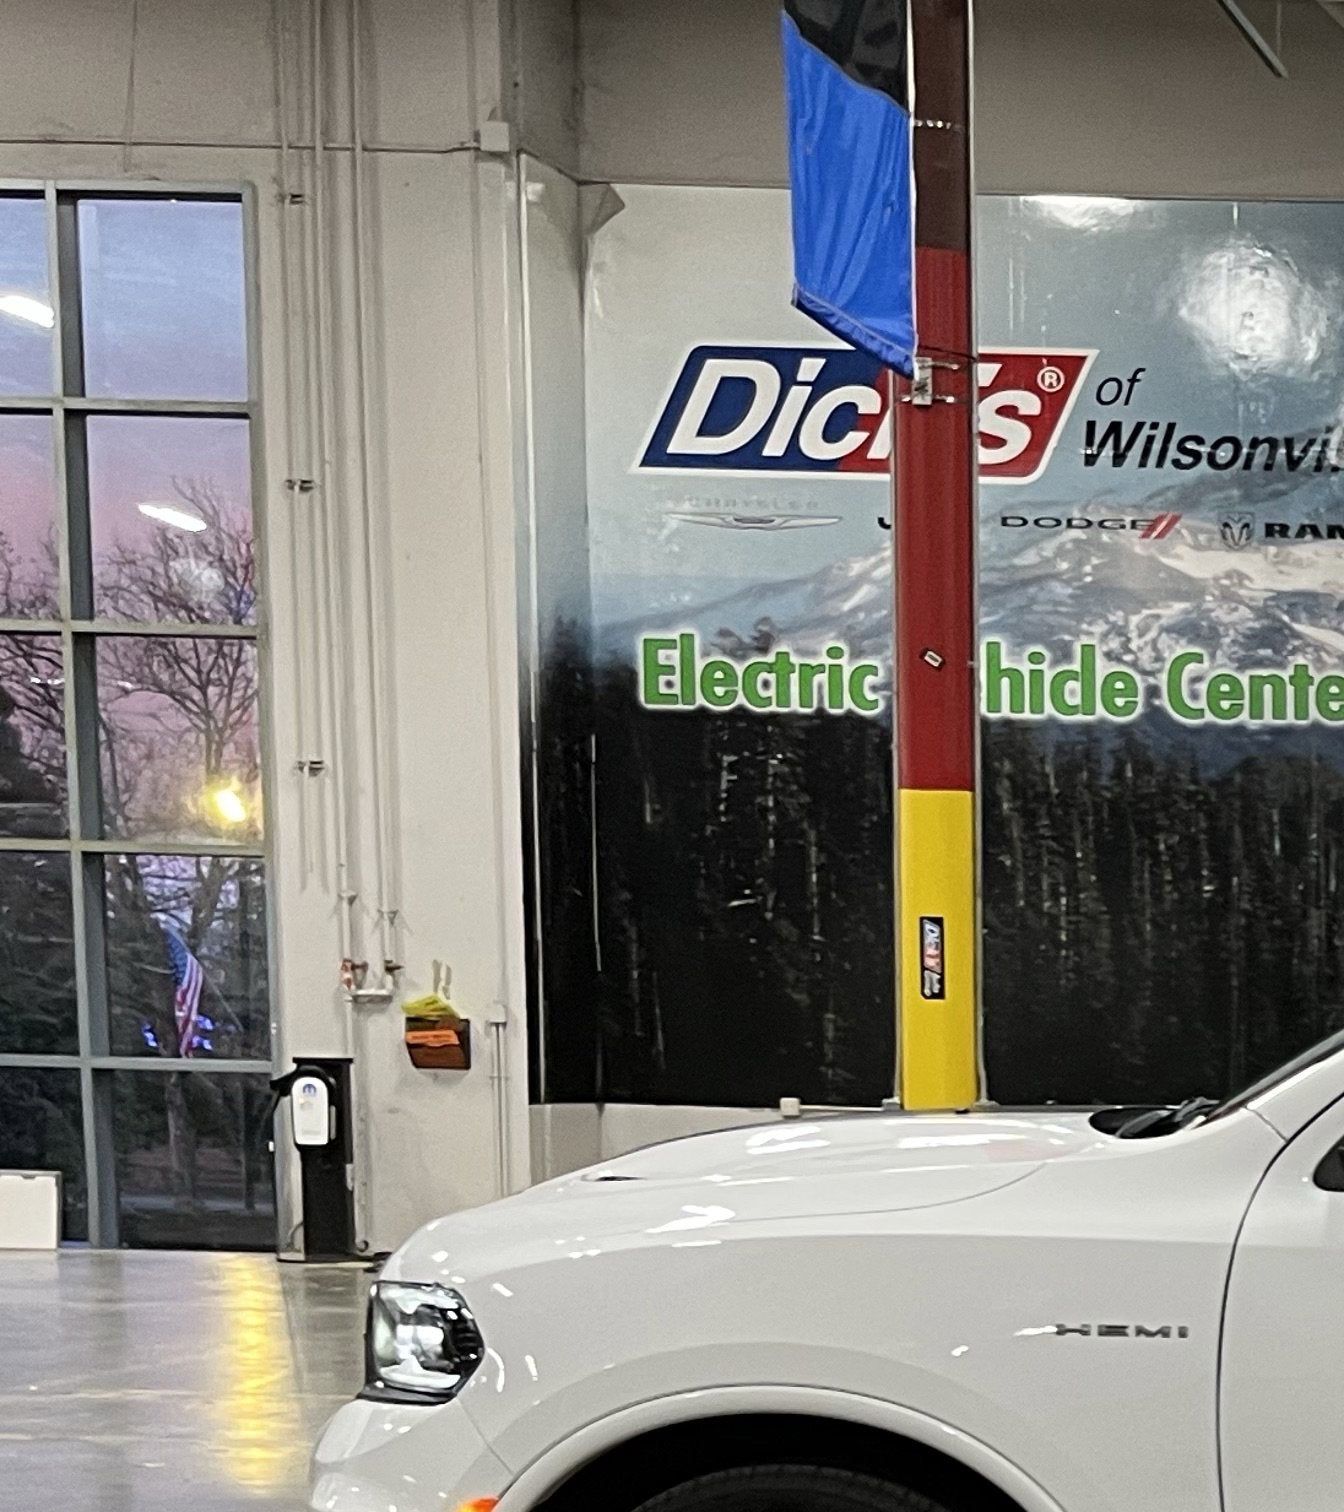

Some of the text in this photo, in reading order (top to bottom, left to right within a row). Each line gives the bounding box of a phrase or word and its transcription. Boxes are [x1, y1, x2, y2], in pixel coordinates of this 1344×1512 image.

[1096, 367, 1146, 406] of
[667, 357, 1042, 467] Dic's
[1001, 516, 1156, 530] DODGE
[643, 633, 879, 711] Electric
[986, 641, 1139, 717] hicle
[1055, 1323, 1188, 1338] HEMI
